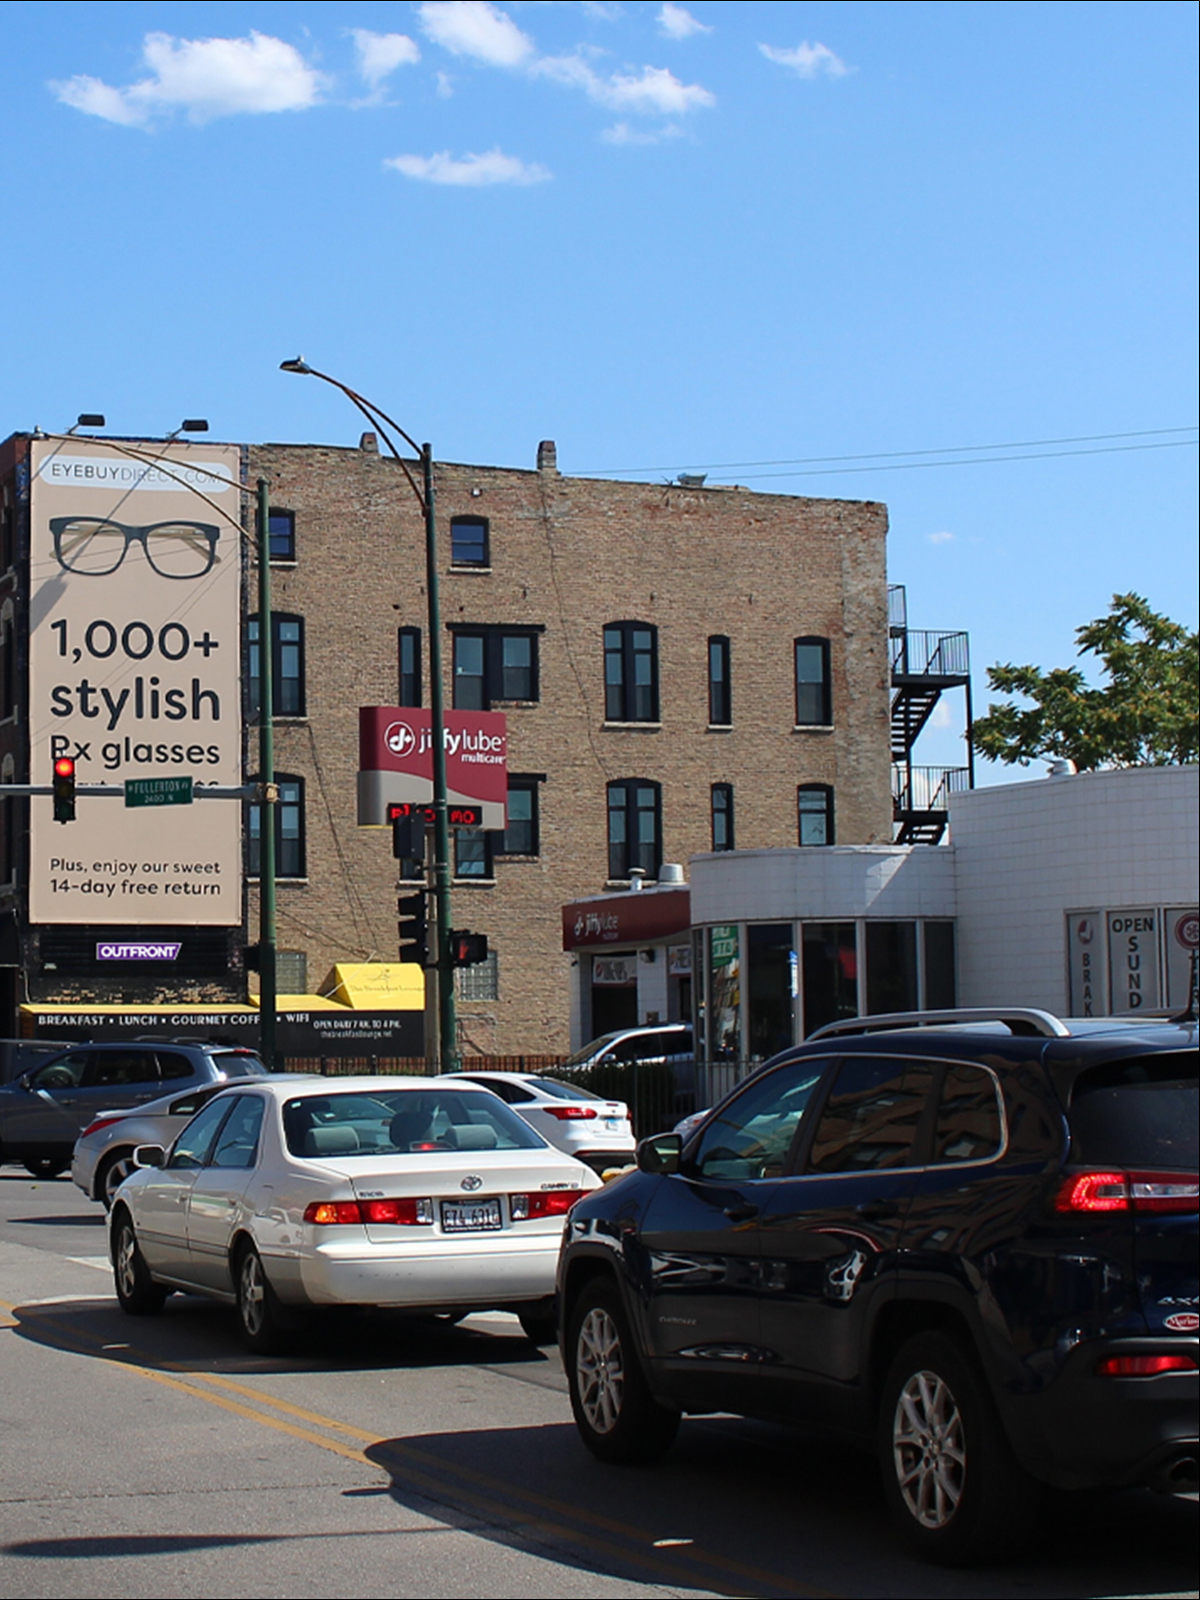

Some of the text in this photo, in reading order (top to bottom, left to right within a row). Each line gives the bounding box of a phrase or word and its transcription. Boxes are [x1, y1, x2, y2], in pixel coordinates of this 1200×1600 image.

[51, 463, 221, 484] EYEBUYDIRECTCOM
[50, 618, 219, 664] 1,000+
[50, 676, 220, 731] stylish
[50, 735, 220, 770] Rx glasses
[461, 753, 504, 764] multicare
[134, 781, 180, 794] FULLERTON
[144, 794, 165, 803] 2400
[50, 858, 221, 876] Plus, enjoy our sweet
[50, 879, 221, 897] 14-day free return
[1112, 918, 1154, 933] OPEN
[101, 946, 176, 958] OUTFRONT
[38, 1013, 309, 1026] BREAKFAST LUNCH GOURMET COFF WIFI
